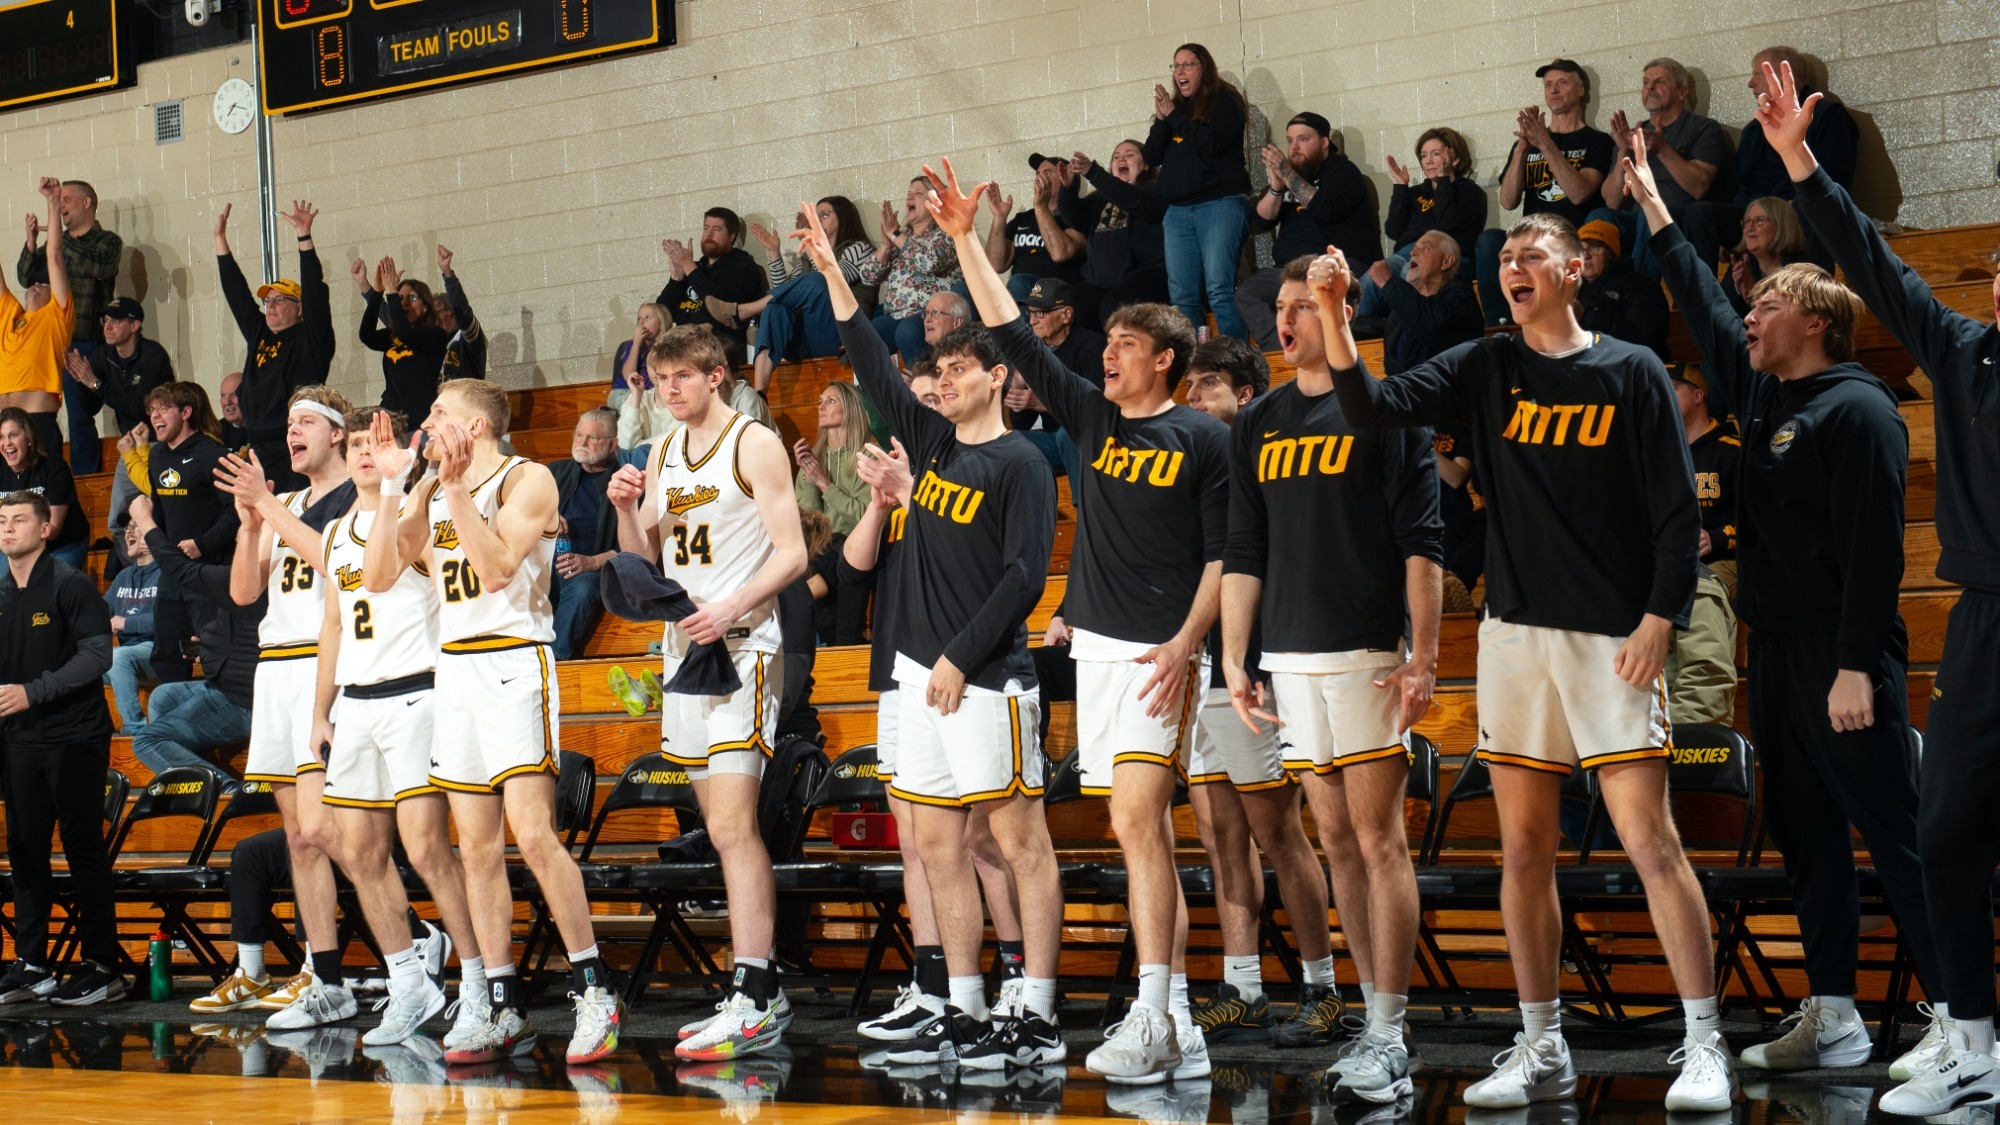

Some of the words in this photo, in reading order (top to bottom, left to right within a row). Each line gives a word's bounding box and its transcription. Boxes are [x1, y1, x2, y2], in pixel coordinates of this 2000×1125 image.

[66, 10, 74, 28] 4
[319, 25, 345, 86] 8
[390, 36, 439, 63] TEAM
[449, 21, 510, 52] FOULS
[1567, 148, 1587, 158] TECH
[1502, 400, 1616, 446] MTU
[1091, 436, 1184, 486] MTU
[1258, 435, 1355, 483] MTU
[666, 485, 720, 516] Huskies
[913, 469, 985, 524] MTU
[672, 523, 713, 566] 34
[281, 555, 315, 594] 33
[441, 557, 483, 603] 20
[353, 598, 375, 640] 2
[1672, 747, 1731, 765] USKIES
[165, 781, 203, 795] HUSKIES
[850, 818, 867, 841] G
